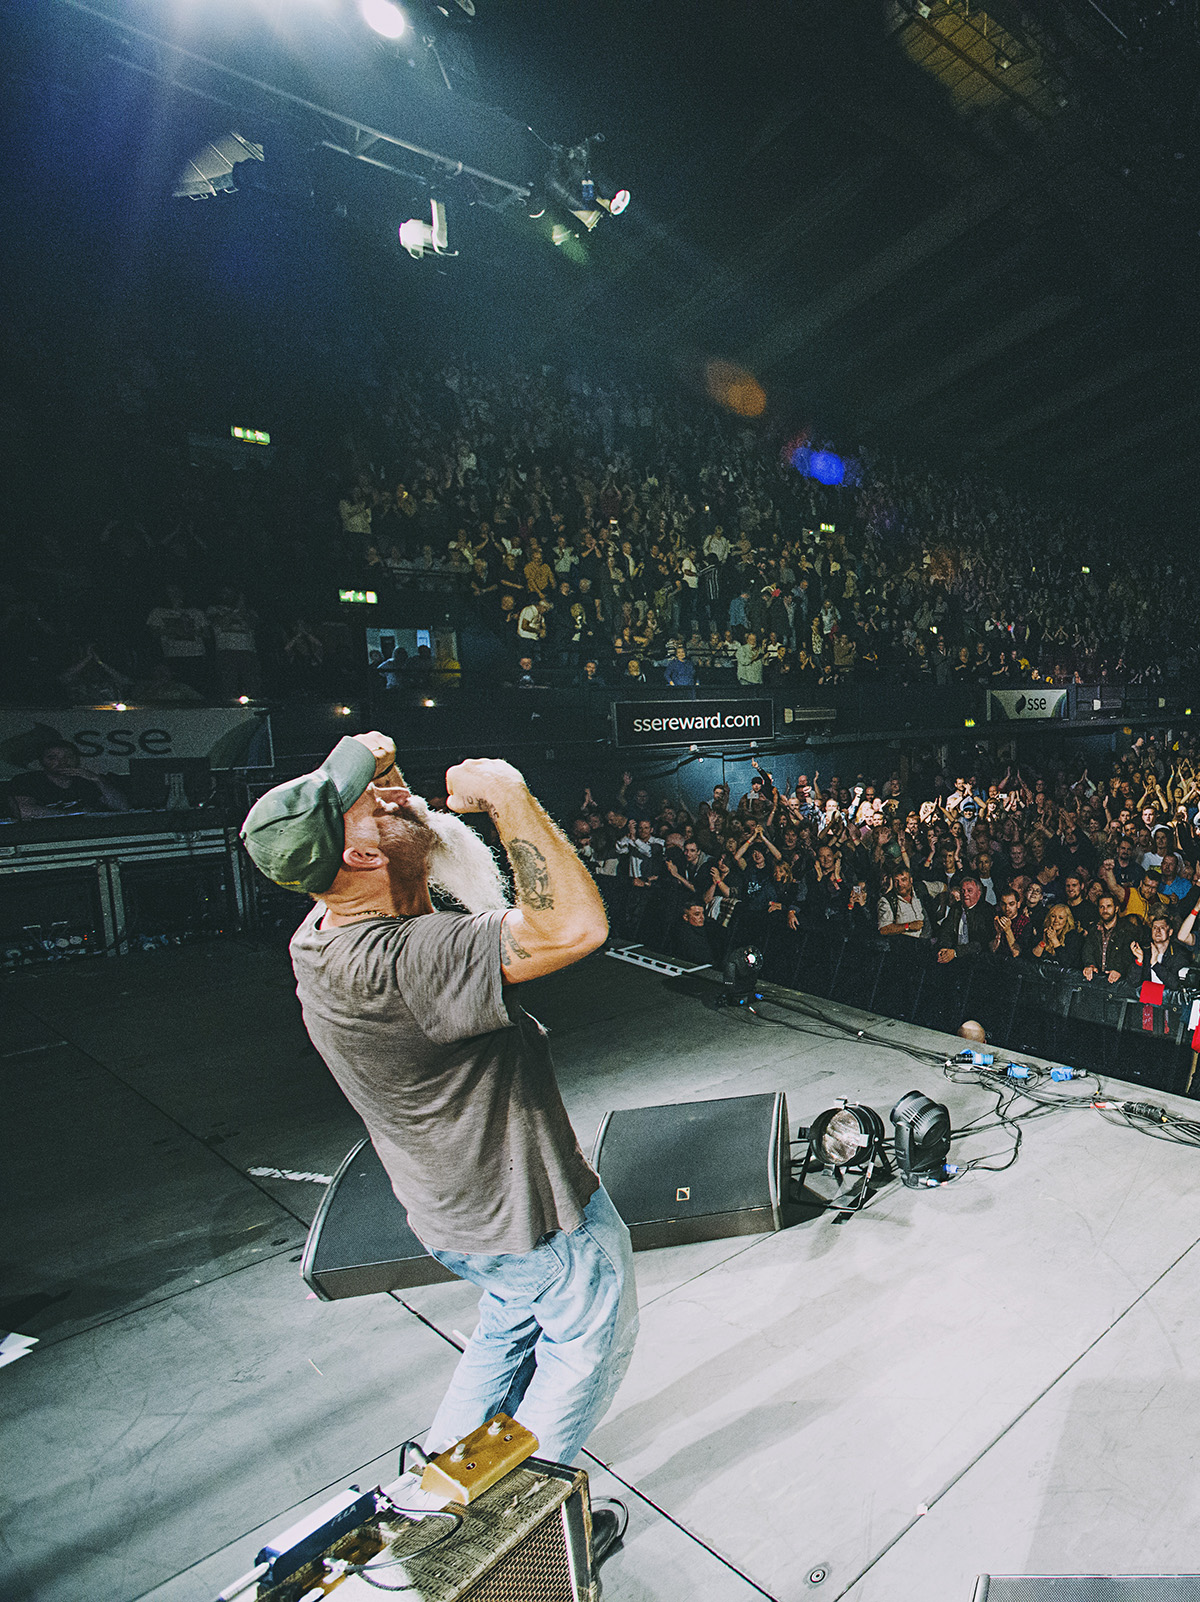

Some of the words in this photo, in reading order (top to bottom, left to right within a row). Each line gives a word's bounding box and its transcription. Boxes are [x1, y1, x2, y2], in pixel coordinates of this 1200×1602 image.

[1027, 697, 1047, 711] sse
[633, 711, 761, 732] ssereward.com
[74, 728, 173, 758] sse
